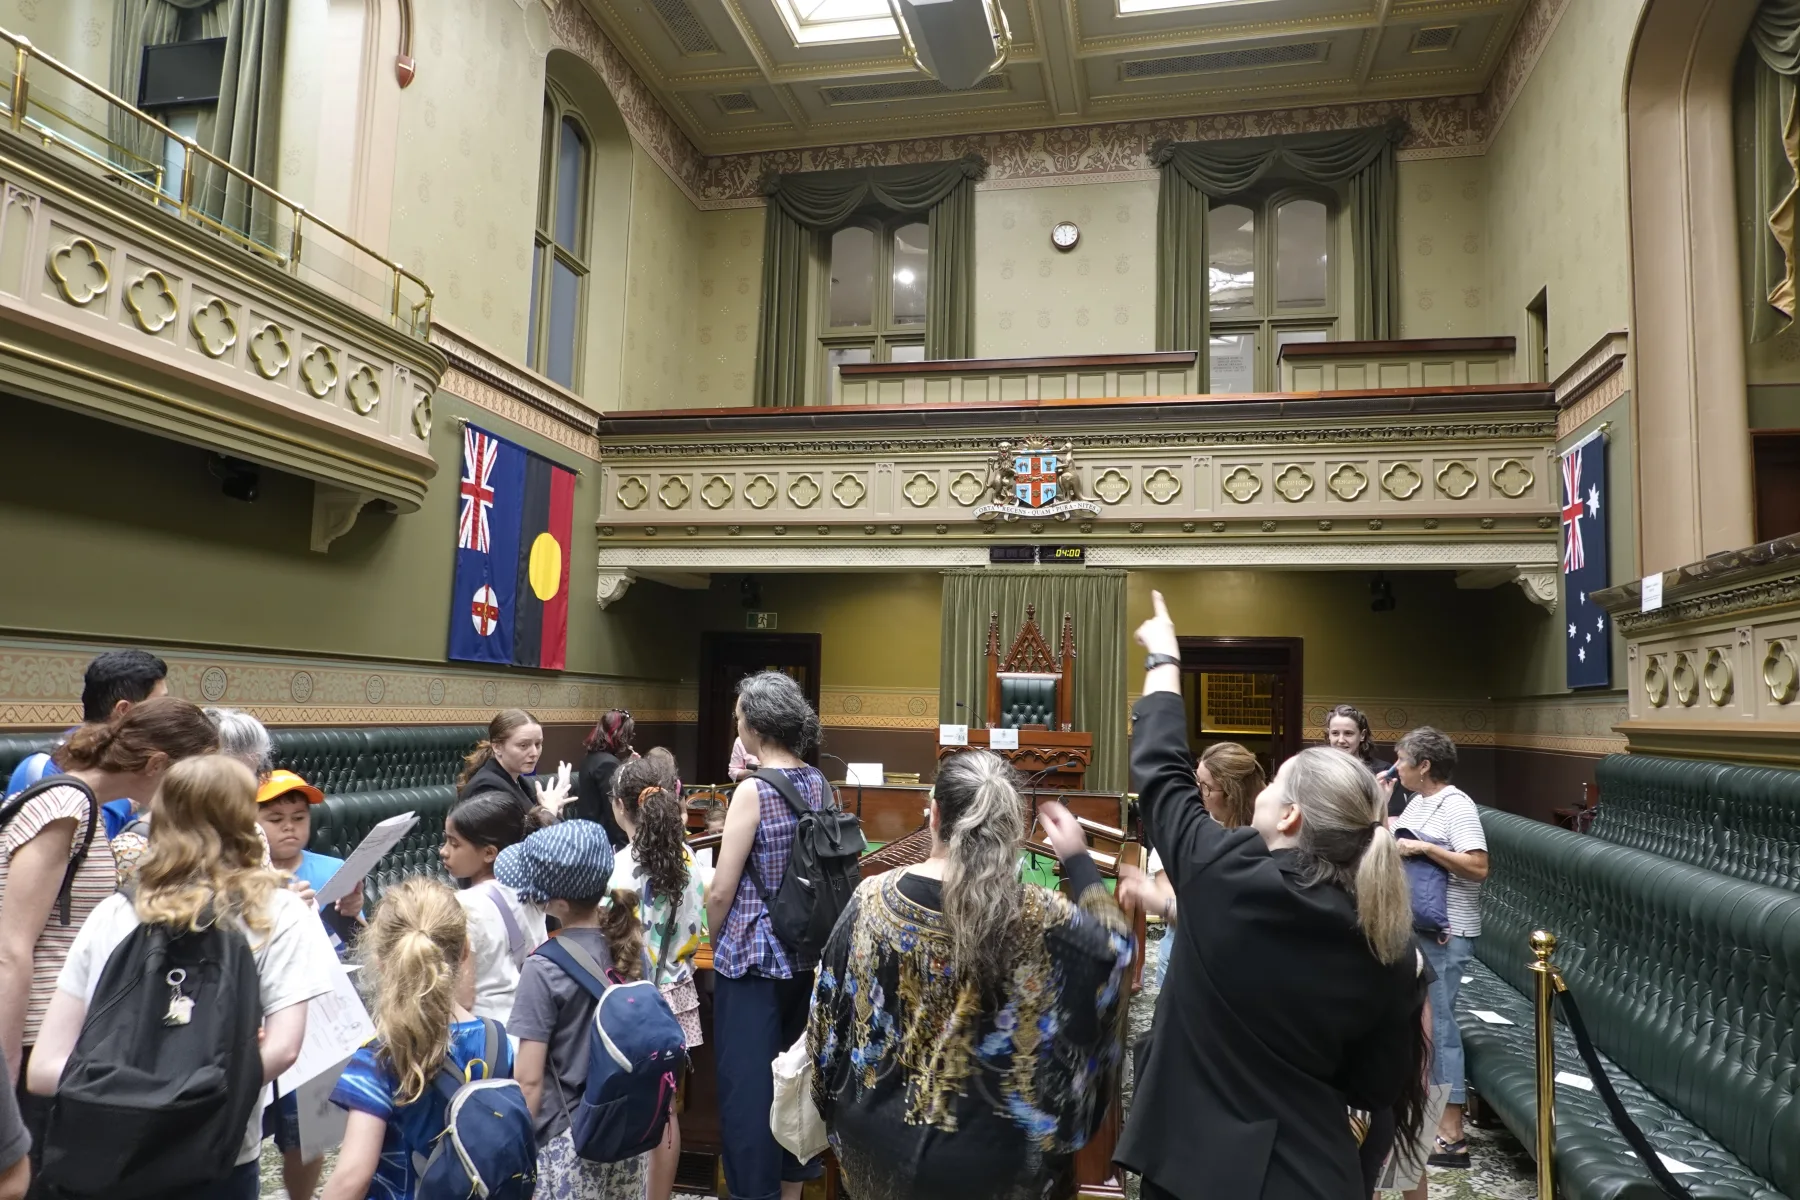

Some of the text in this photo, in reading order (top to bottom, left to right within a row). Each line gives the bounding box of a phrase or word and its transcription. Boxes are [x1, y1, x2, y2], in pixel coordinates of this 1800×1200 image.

[1031, 508, 1051, 516] QUAM
[1056, 504, 1073, 512] PURA
[1077, 502, 1096, 511] NITES
[1055, 548, 1081, 558] 04:00
